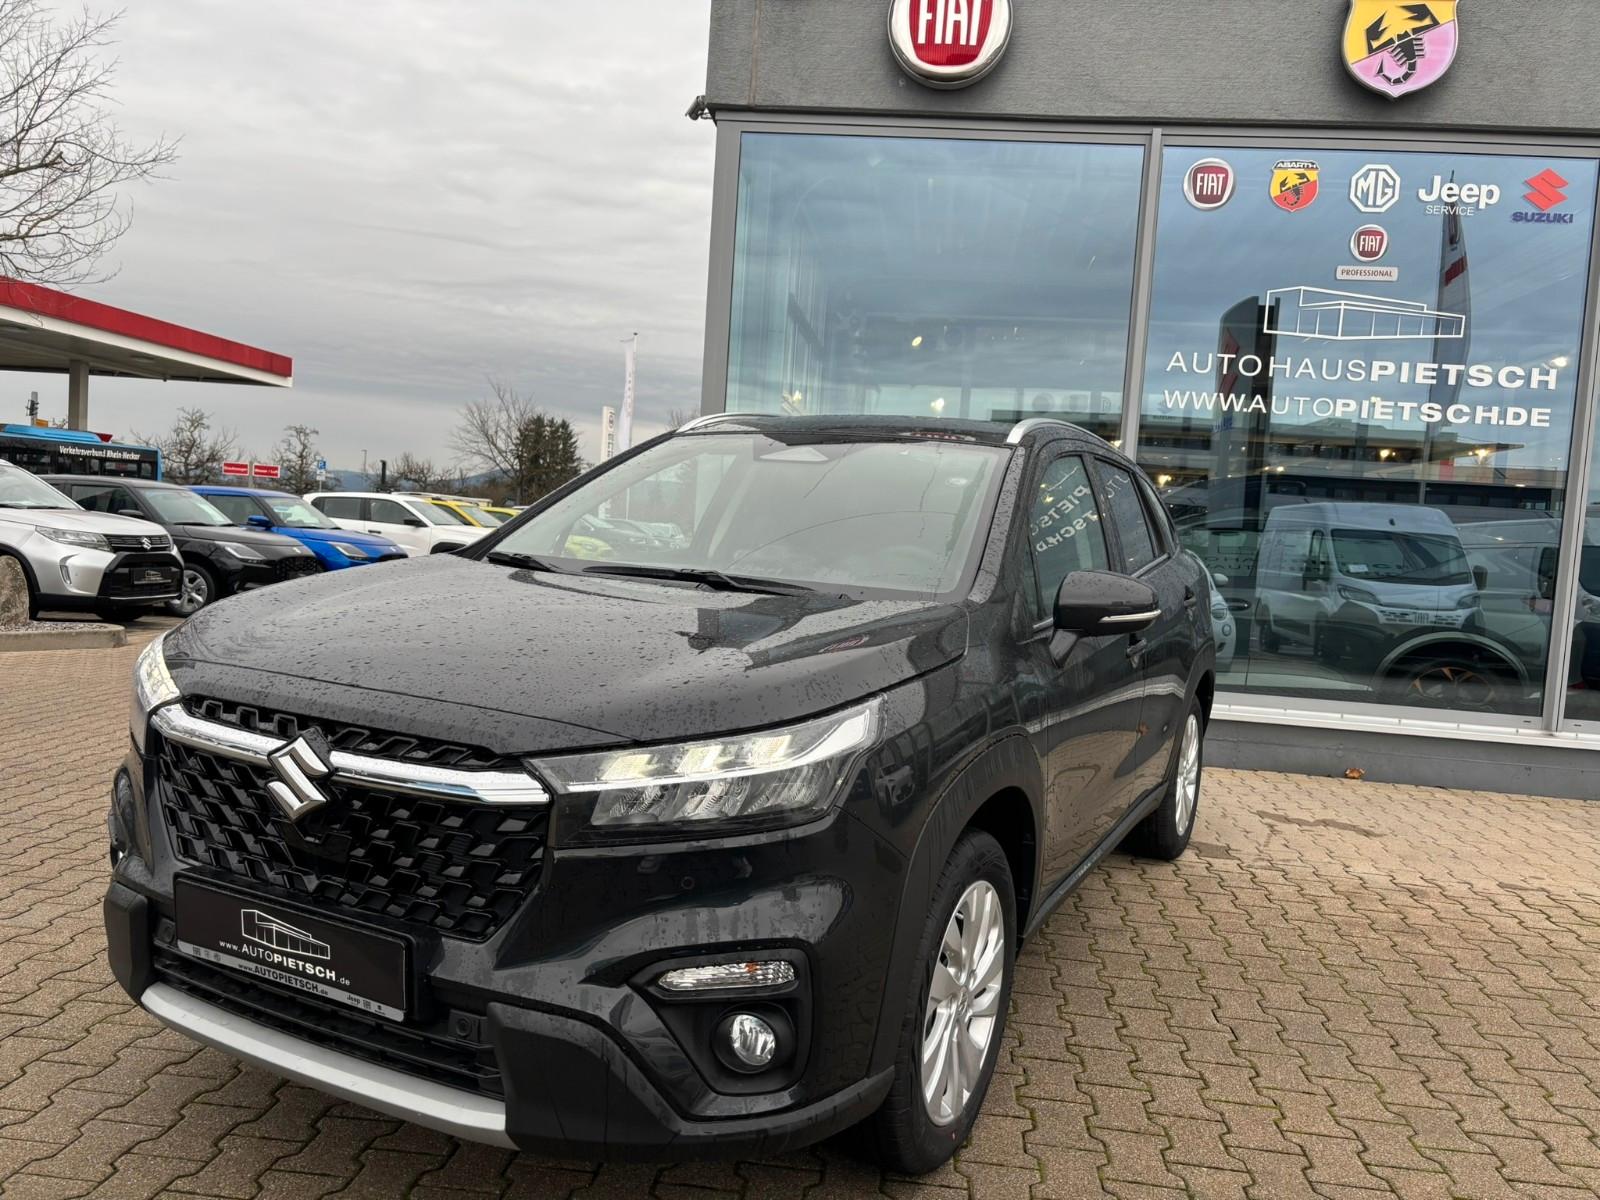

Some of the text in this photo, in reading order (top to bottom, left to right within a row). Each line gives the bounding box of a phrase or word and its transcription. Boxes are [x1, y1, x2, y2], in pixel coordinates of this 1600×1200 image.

[1276, 161, 1317, 169] ABARTH
[1196, 173, 1226, 195] FIAT
[1356, 170, 1394, 206] MG
[1418, 175, 1501, 209] Jeep
[1425, 205, 1475, 216] SERVICE
[1511, 211, 1574, 224] SUZUKI
[1359, 235, 1382, 252] FIAT
[1341, 269, 1393, 278] PROFESSIONAL
[1164, 390, 1551, 427] WWW.AUTOPIETSCH.DE
